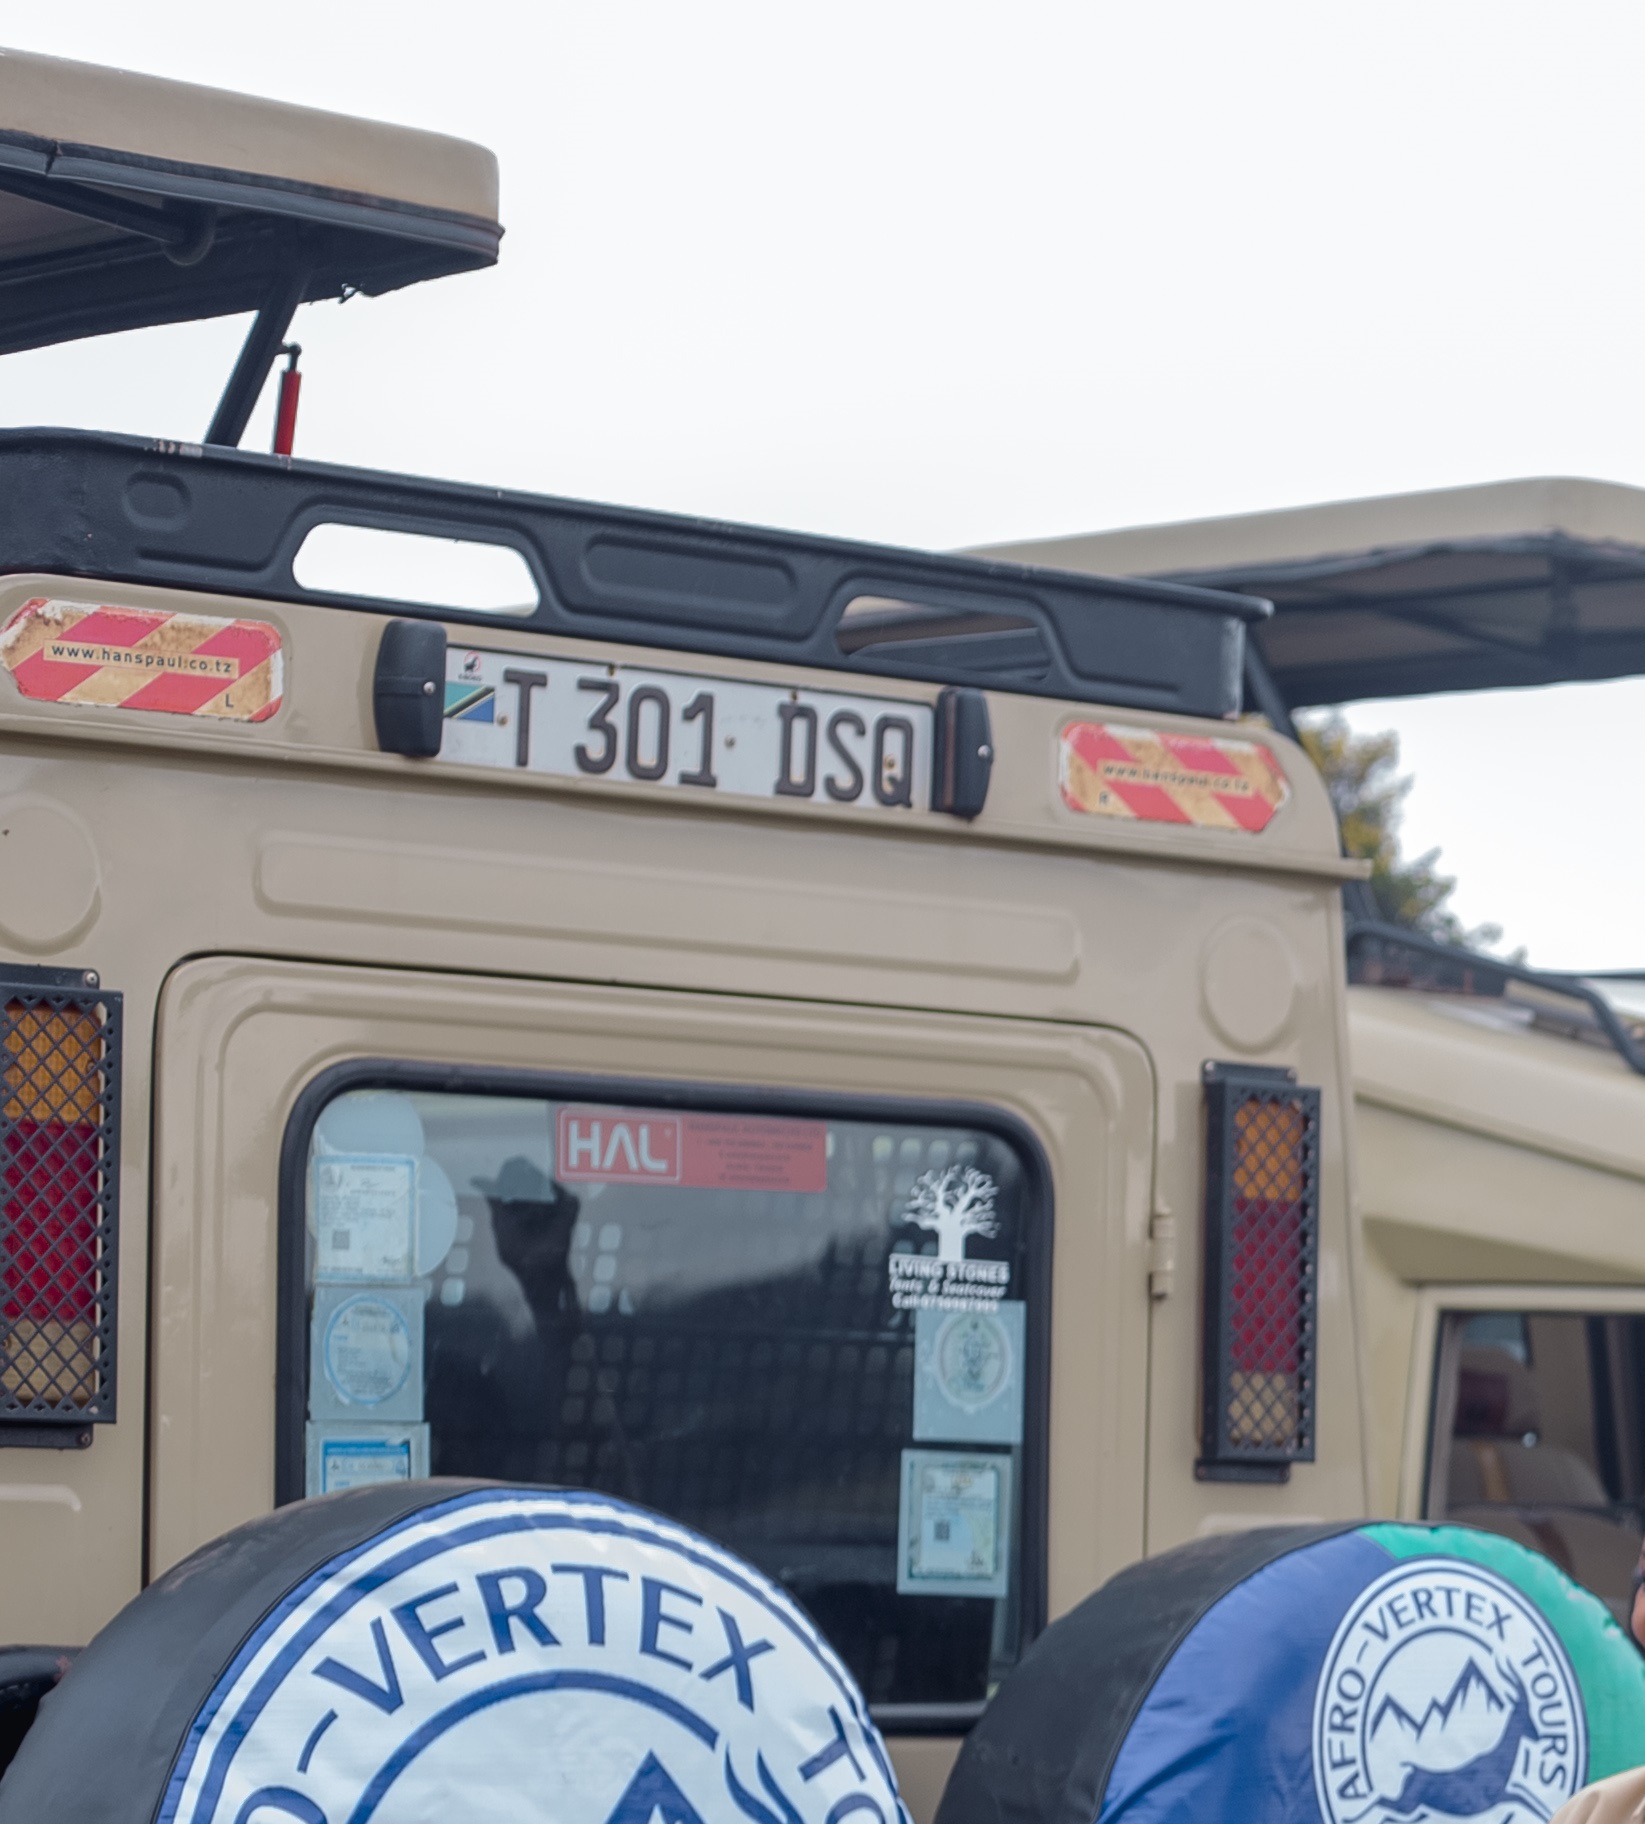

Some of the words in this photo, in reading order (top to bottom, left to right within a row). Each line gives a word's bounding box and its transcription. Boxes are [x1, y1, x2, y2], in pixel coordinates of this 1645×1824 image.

[50, 644, 232, 674] www.hanspaul.co.tz
[224, 693, 235, 709] L
[503, 667, 547, 767] T
[573, 676, 718, 788] 301
[774, 702, 914, 809] DSQ
[1327, 1585, 1514, 1802] AFRO-VERTEX
[1521, 1638, 1570, 1791] TOURS
